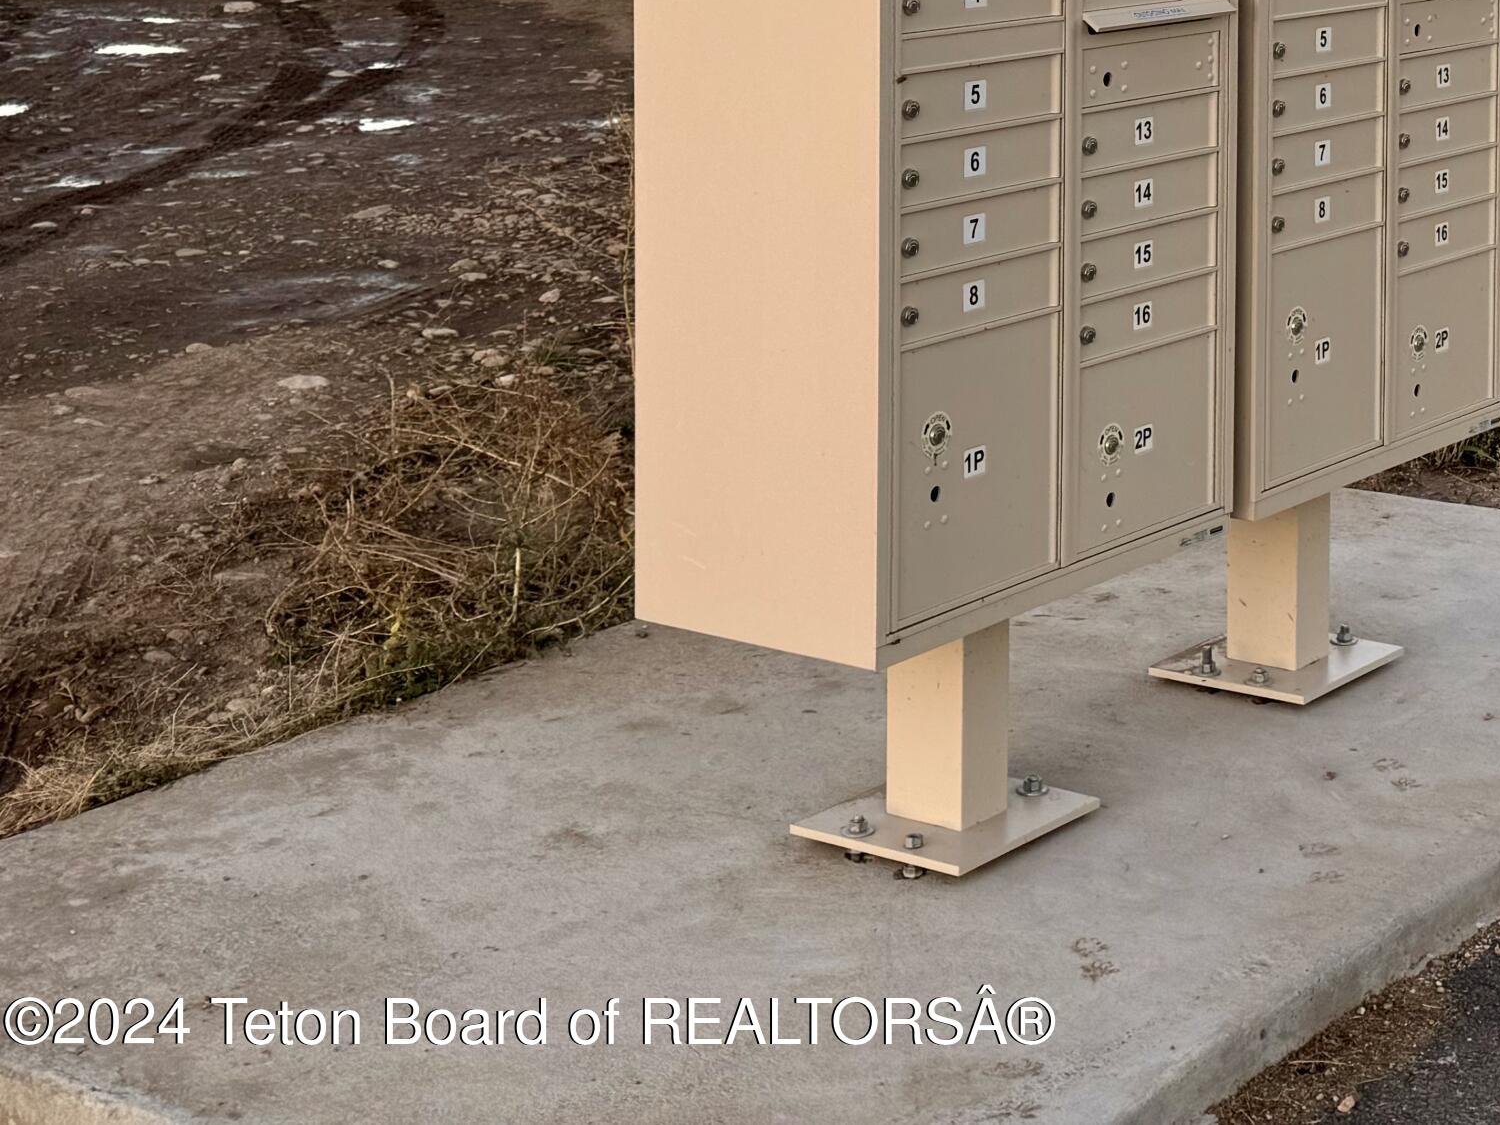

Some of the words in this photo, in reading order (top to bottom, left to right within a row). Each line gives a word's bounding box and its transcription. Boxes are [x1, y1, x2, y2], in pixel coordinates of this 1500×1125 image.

[1320, 30, 1328, 48] 5
[1437, 67, 1450, 85] 13
[970, 83, 981, 105] 5
[1319, 87, 1327, 105] 6
[1135, 120, 1152, 141] 13
[1436, 120, 1449, 138] 14
[970, 151, 980, 172] 6
[1318, 143, 1326, 162] 7
[1436, 172, 1448, 190] 15
[1135, 182, 1152, 203] 14
[1318, 200, 1326, 219] 8
[969, 218, 979, 239] 7
[1436, 224, 1448, 243] 16
[1135, 243, 1152, 265] 15
[969, 284, 979, 306] 8
[1134, 304, 1151, 326] 16
[1435, 330, 1449, 349] 2P
[1315, 340, 1330, 361] 1P
[1134, 427, 1152, 450] 2P
[964, 449, 985, 474] 1P
